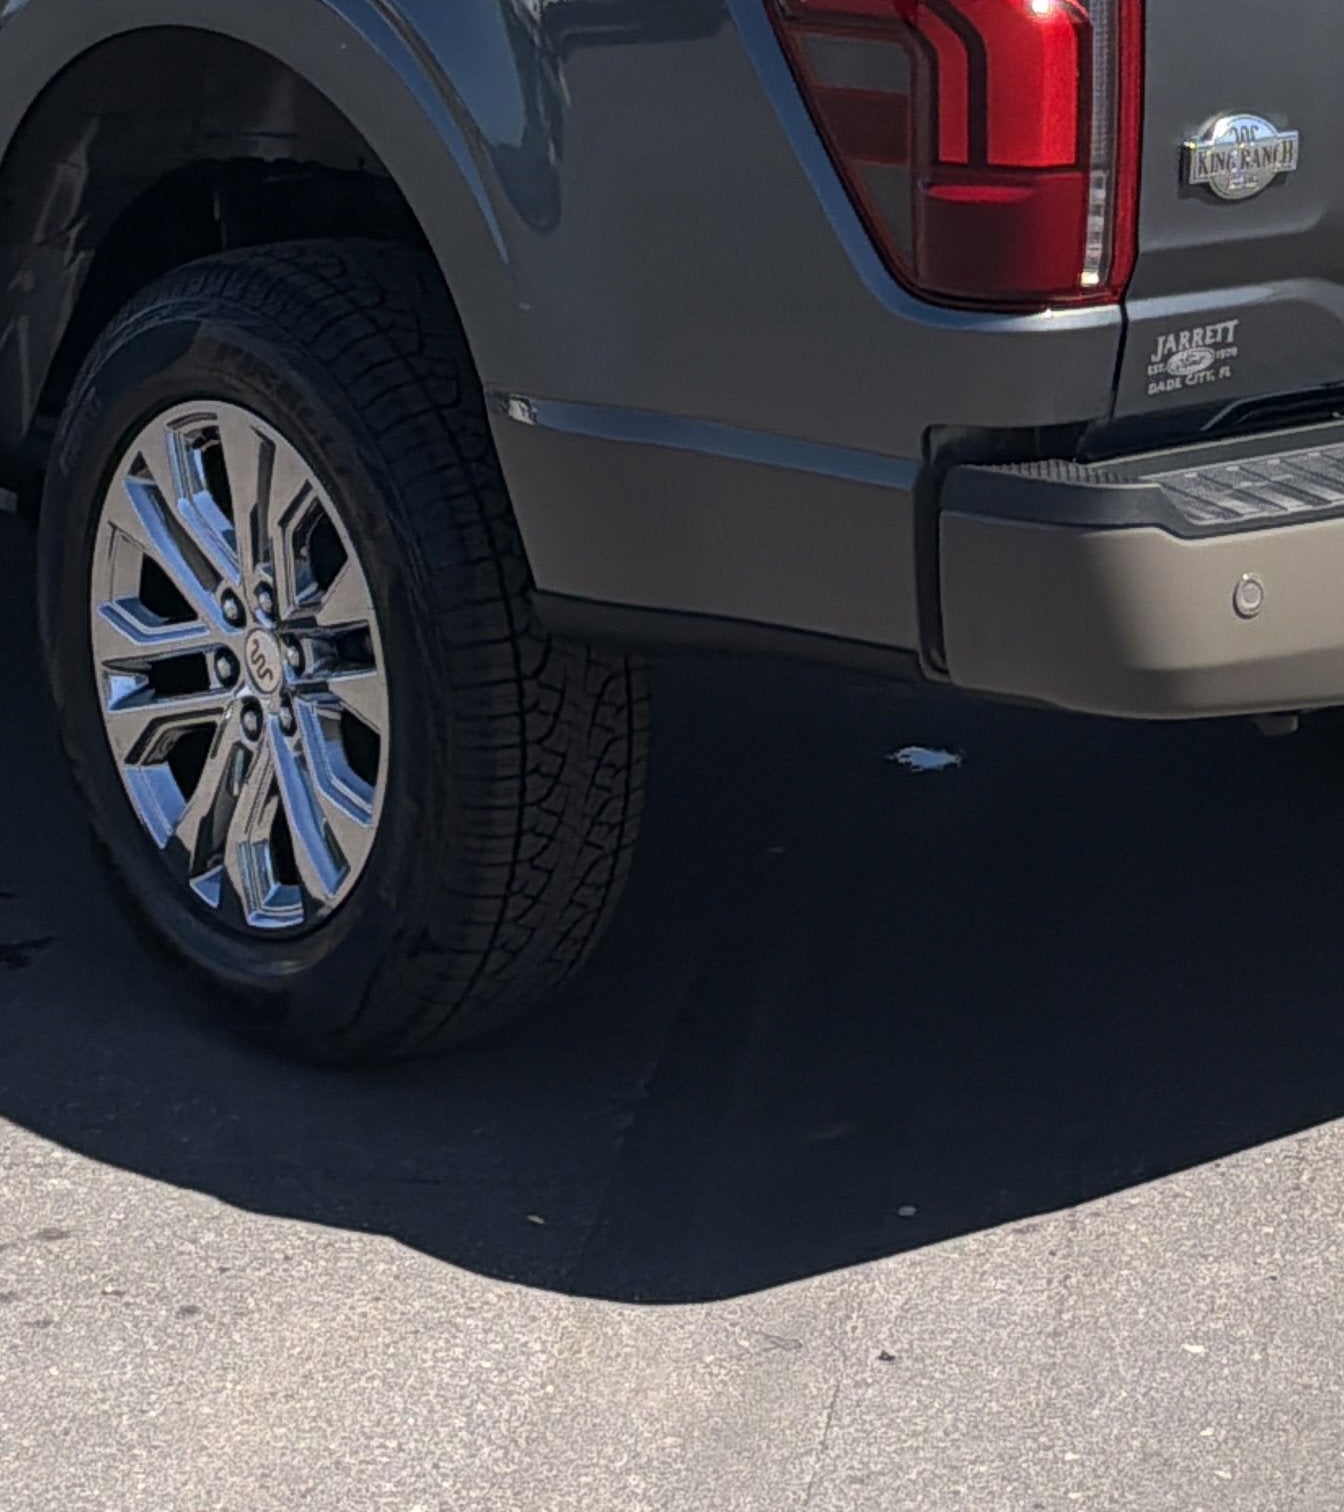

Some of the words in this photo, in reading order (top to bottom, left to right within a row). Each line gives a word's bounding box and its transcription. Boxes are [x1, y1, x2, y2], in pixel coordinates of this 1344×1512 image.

[1197, 149, 1238, 178] KING
[1240, 139, 1294, 171] RANCH
[1150, 318, 1240, 363] JARRETT
[1147, 376, 1183, 396] DADE
[1218, 365, 1232, 379] FL
